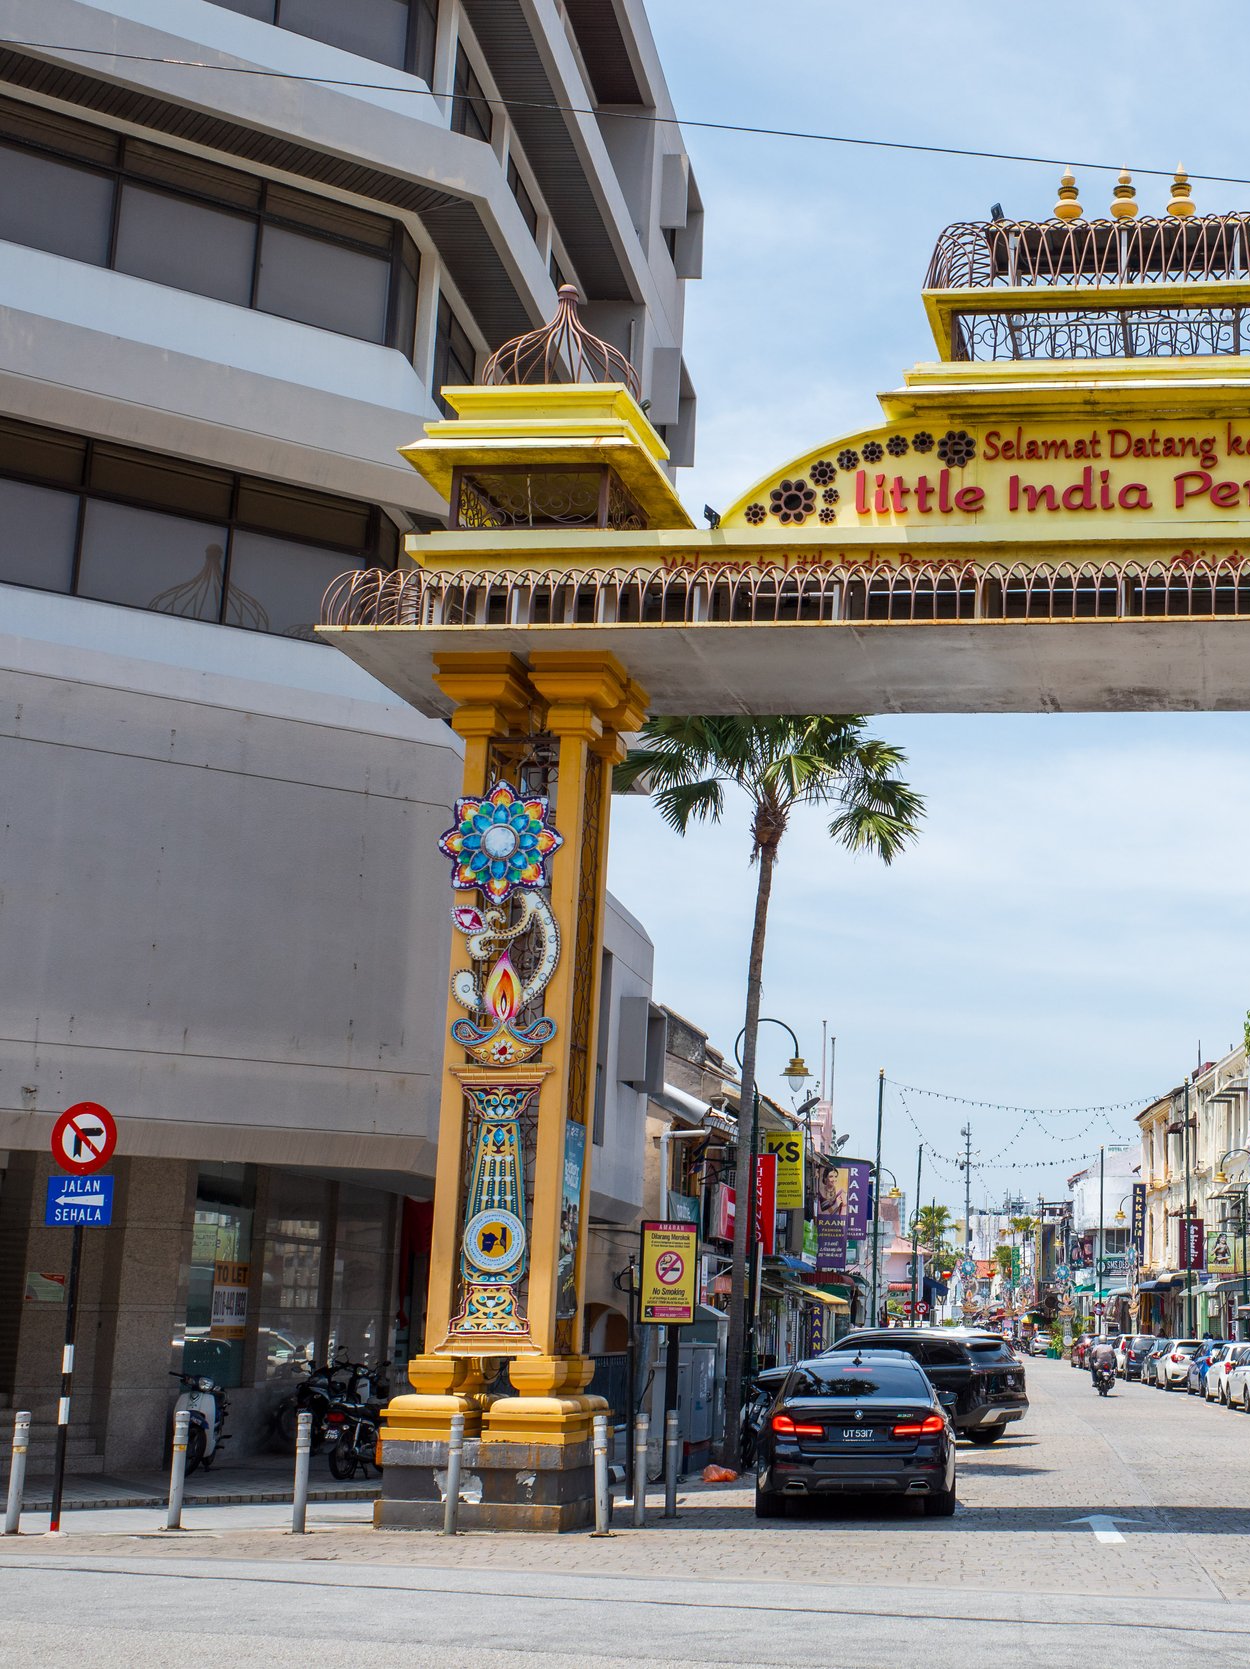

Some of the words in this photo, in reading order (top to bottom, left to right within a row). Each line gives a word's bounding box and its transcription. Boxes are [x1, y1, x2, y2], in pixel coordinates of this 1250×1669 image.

[983, 426, 1101, 460] Selamat
[1108, 429, 1218, 468] Datang
[855, 468, 986, 514] little
[1009, 465, 1153, 512] India
[659, 552, 753, 576] Welcome
[757, 554, 776, 573] to
[782, 550, 833, 574] Little
[840, 550, 891, 573] India
[899, 552, 976, 579] Penang
[768, 1141, 800, 1163] KS
[61, 1180, 100, 1193] JALAN
[849, 1168, 859, 1226] RAANI
[54, 1208, 101, 1221] SEHALA
[651, 1232, 670, 1241] Dilarang
[671, 1233, 690, 1241] Merokok
[217, 1265, 229, 1283] TO
[232, 1266, 248, 1284] LET
[652, 1287, 661, 1296] No
[661, 1288, 685, 1297] Smoking
[843, 1429, 855, 1438] UT
[855, 1429, 874, 1438] 5317
